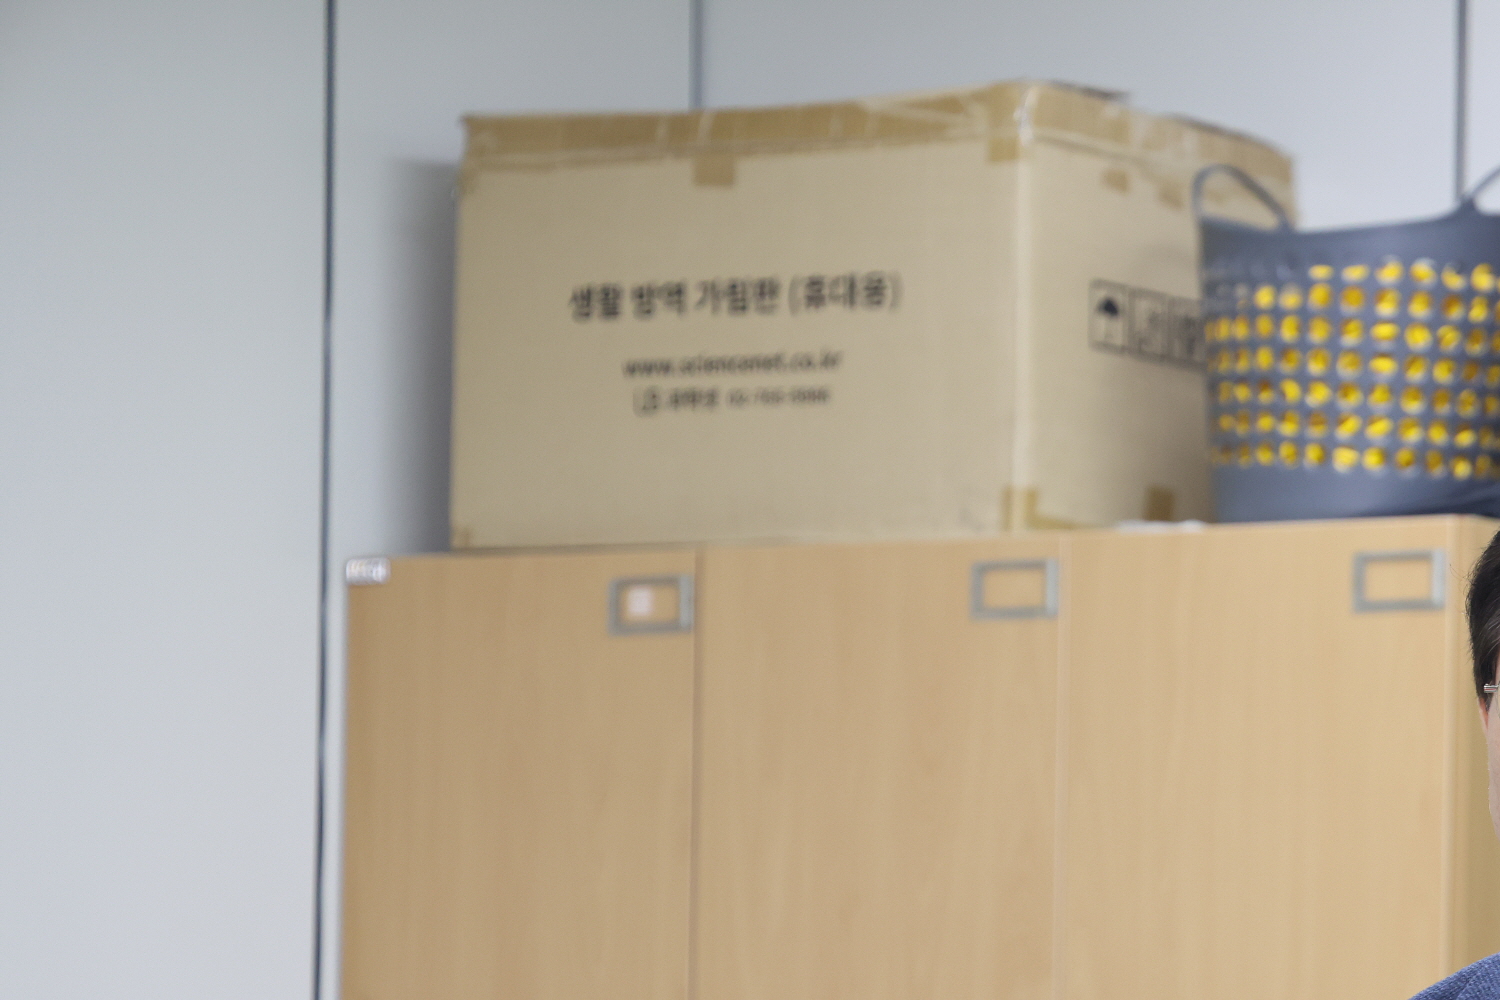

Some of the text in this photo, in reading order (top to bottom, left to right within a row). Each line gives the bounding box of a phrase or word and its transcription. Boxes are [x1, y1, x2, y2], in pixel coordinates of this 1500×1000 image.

[568, 280, 623, 322] 생활
[631, 278, 687, 319] 방역
[694, 275, 781, 315] 가림판
